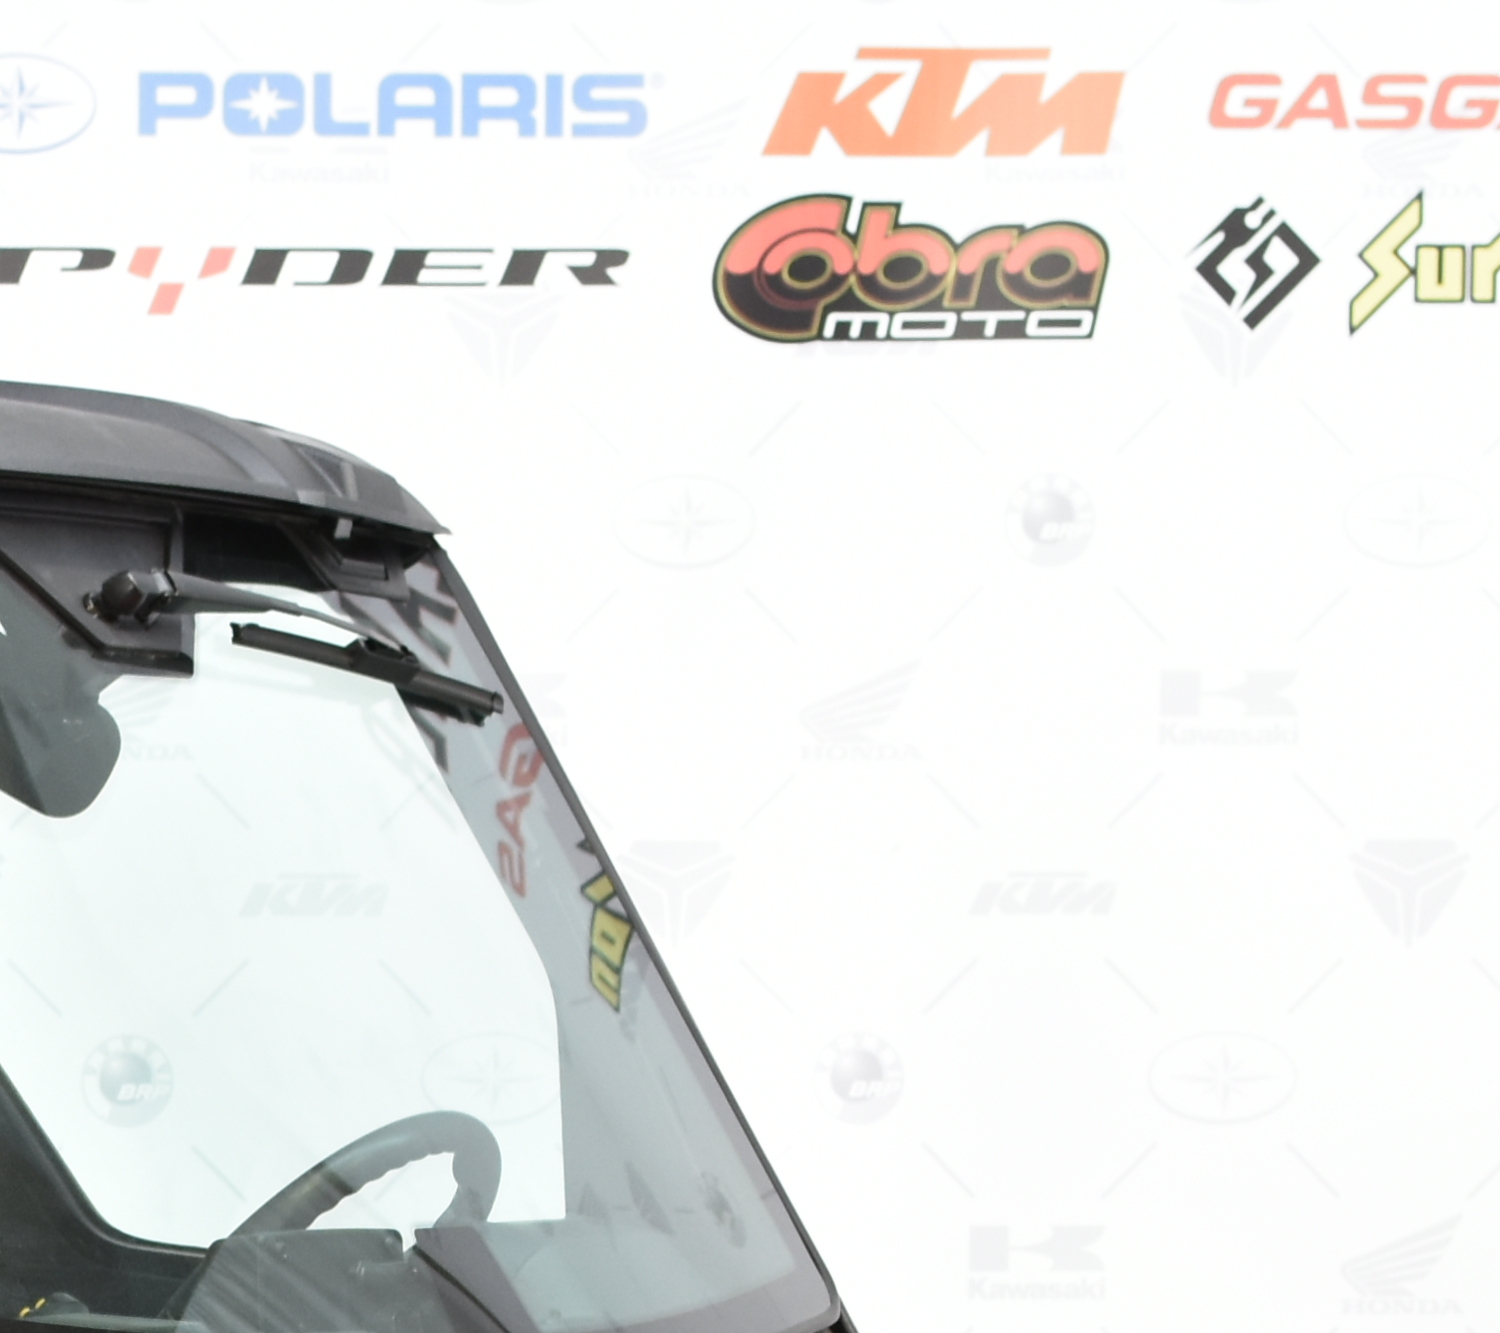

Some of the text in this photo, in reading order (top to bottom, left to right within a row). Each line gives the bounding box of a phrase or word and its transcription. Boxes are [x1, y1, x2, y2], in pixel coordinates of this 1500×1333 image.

[136, 72, 649, 139] POLARIS
[762, 46, 1127, 156] KTM
[711, 192, 1111, 343] Cobra
[822, 310, 1096, 341] MOTO
[238, 871, 389, 918] KTM
[969, 870, 1116, 916] KTM
